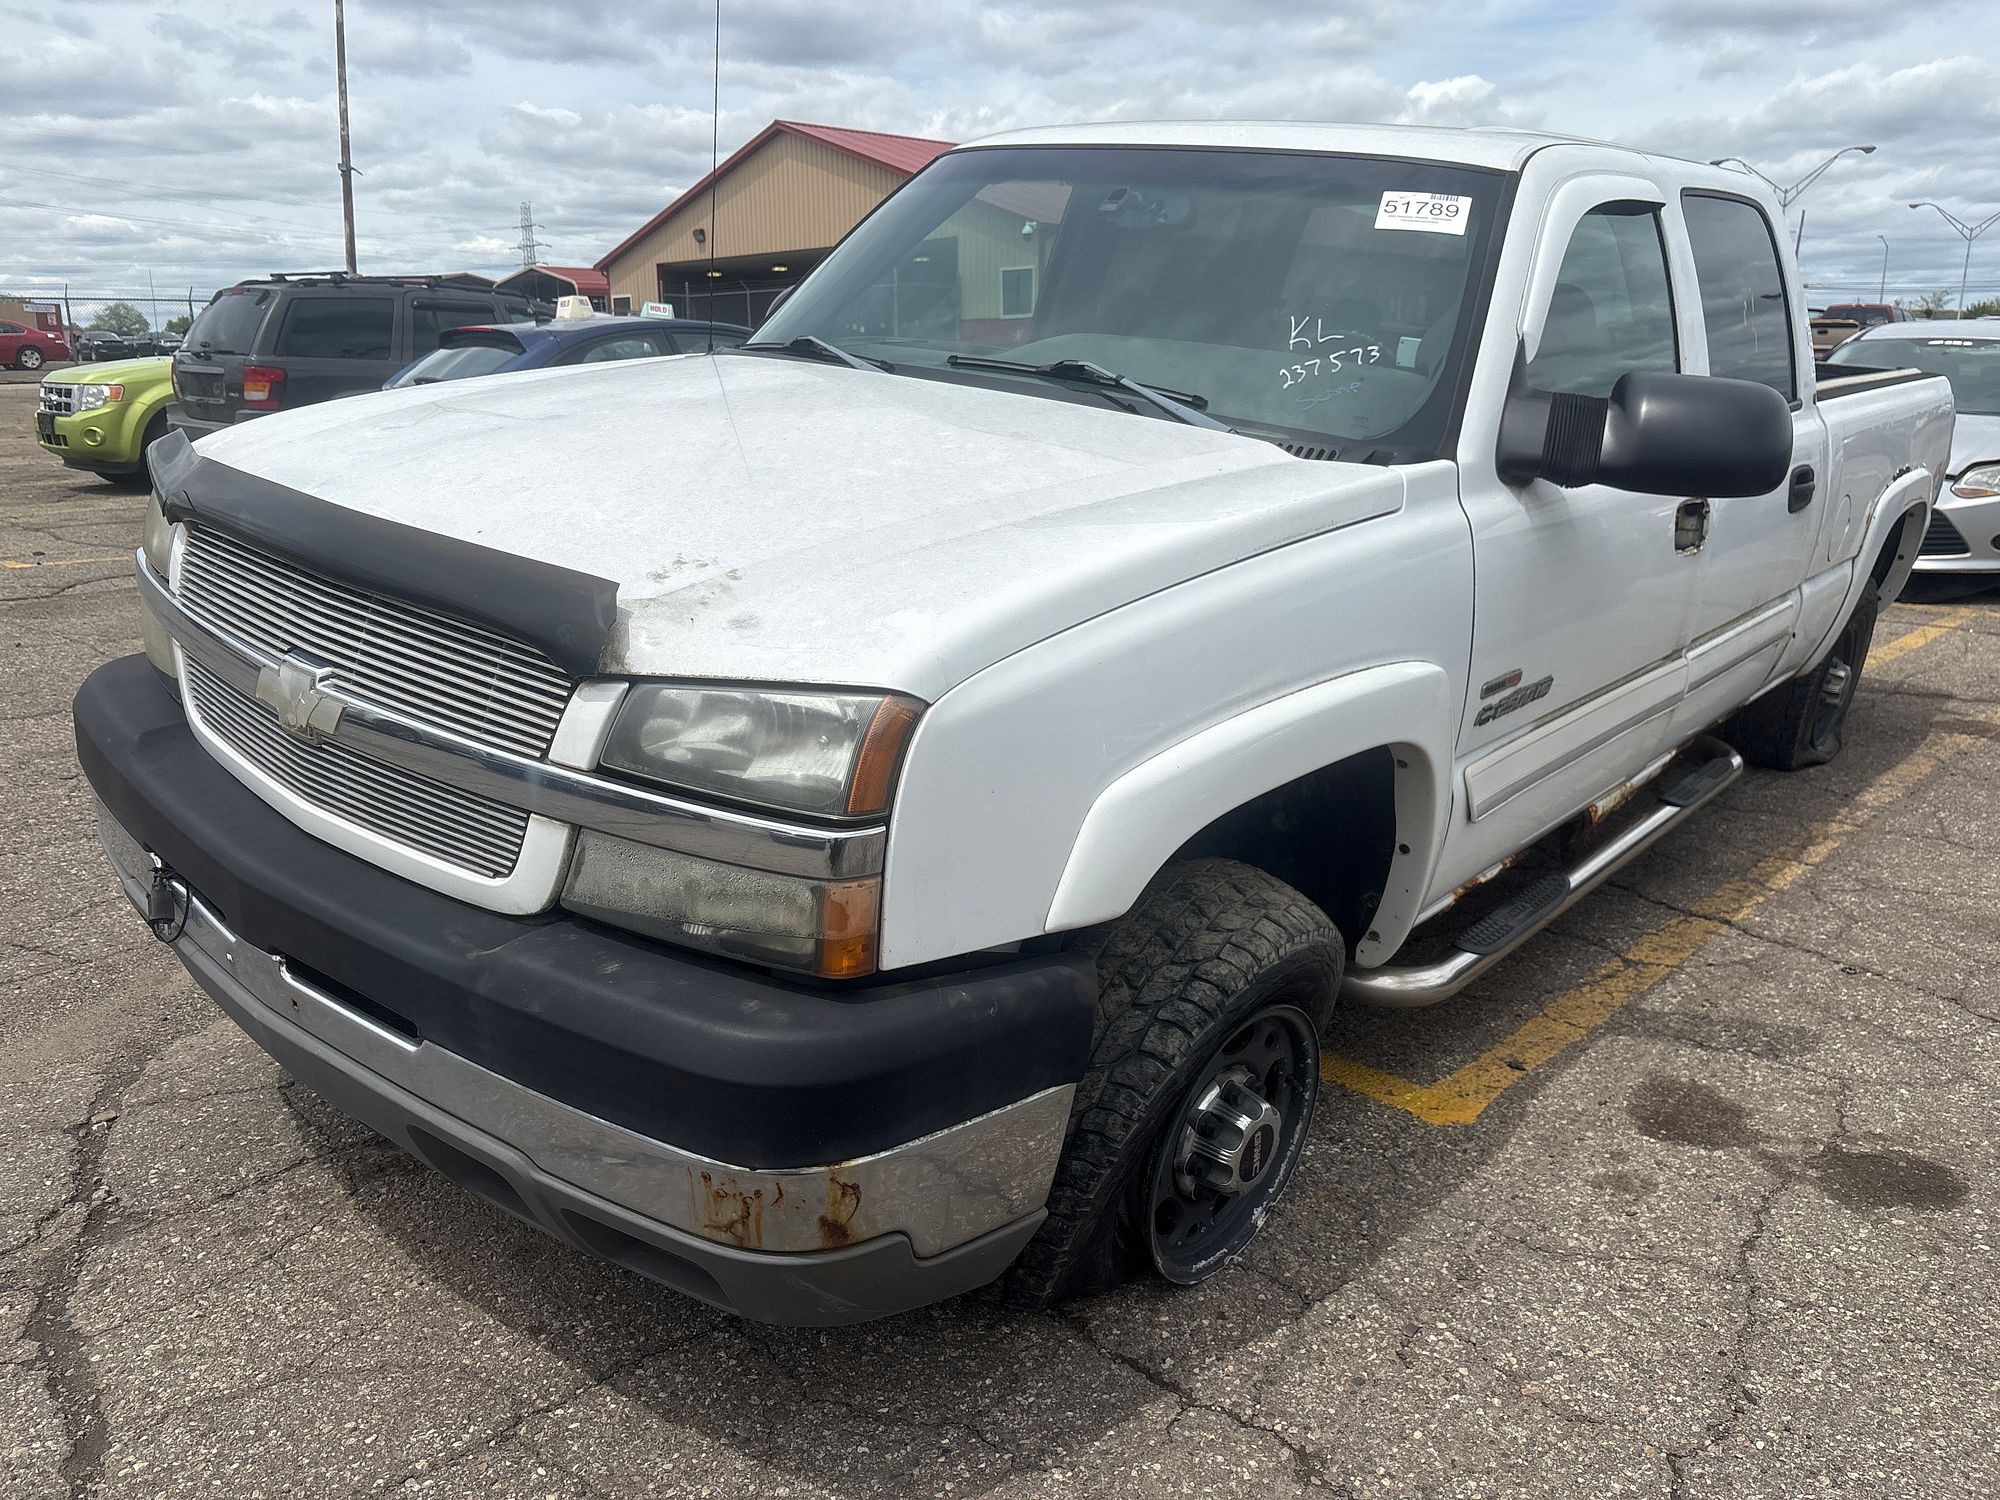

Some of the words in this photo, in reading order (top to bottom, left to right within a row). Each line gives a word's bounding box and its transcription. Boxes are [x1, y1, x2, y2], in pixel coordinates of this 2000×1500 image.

[1383, 200, 1460, 218] 51789
[649, 304, 668, 314] HOLD
[1289, 315, 1345, 351] KL
[1252, 1130, 1262, 1177] GMC
